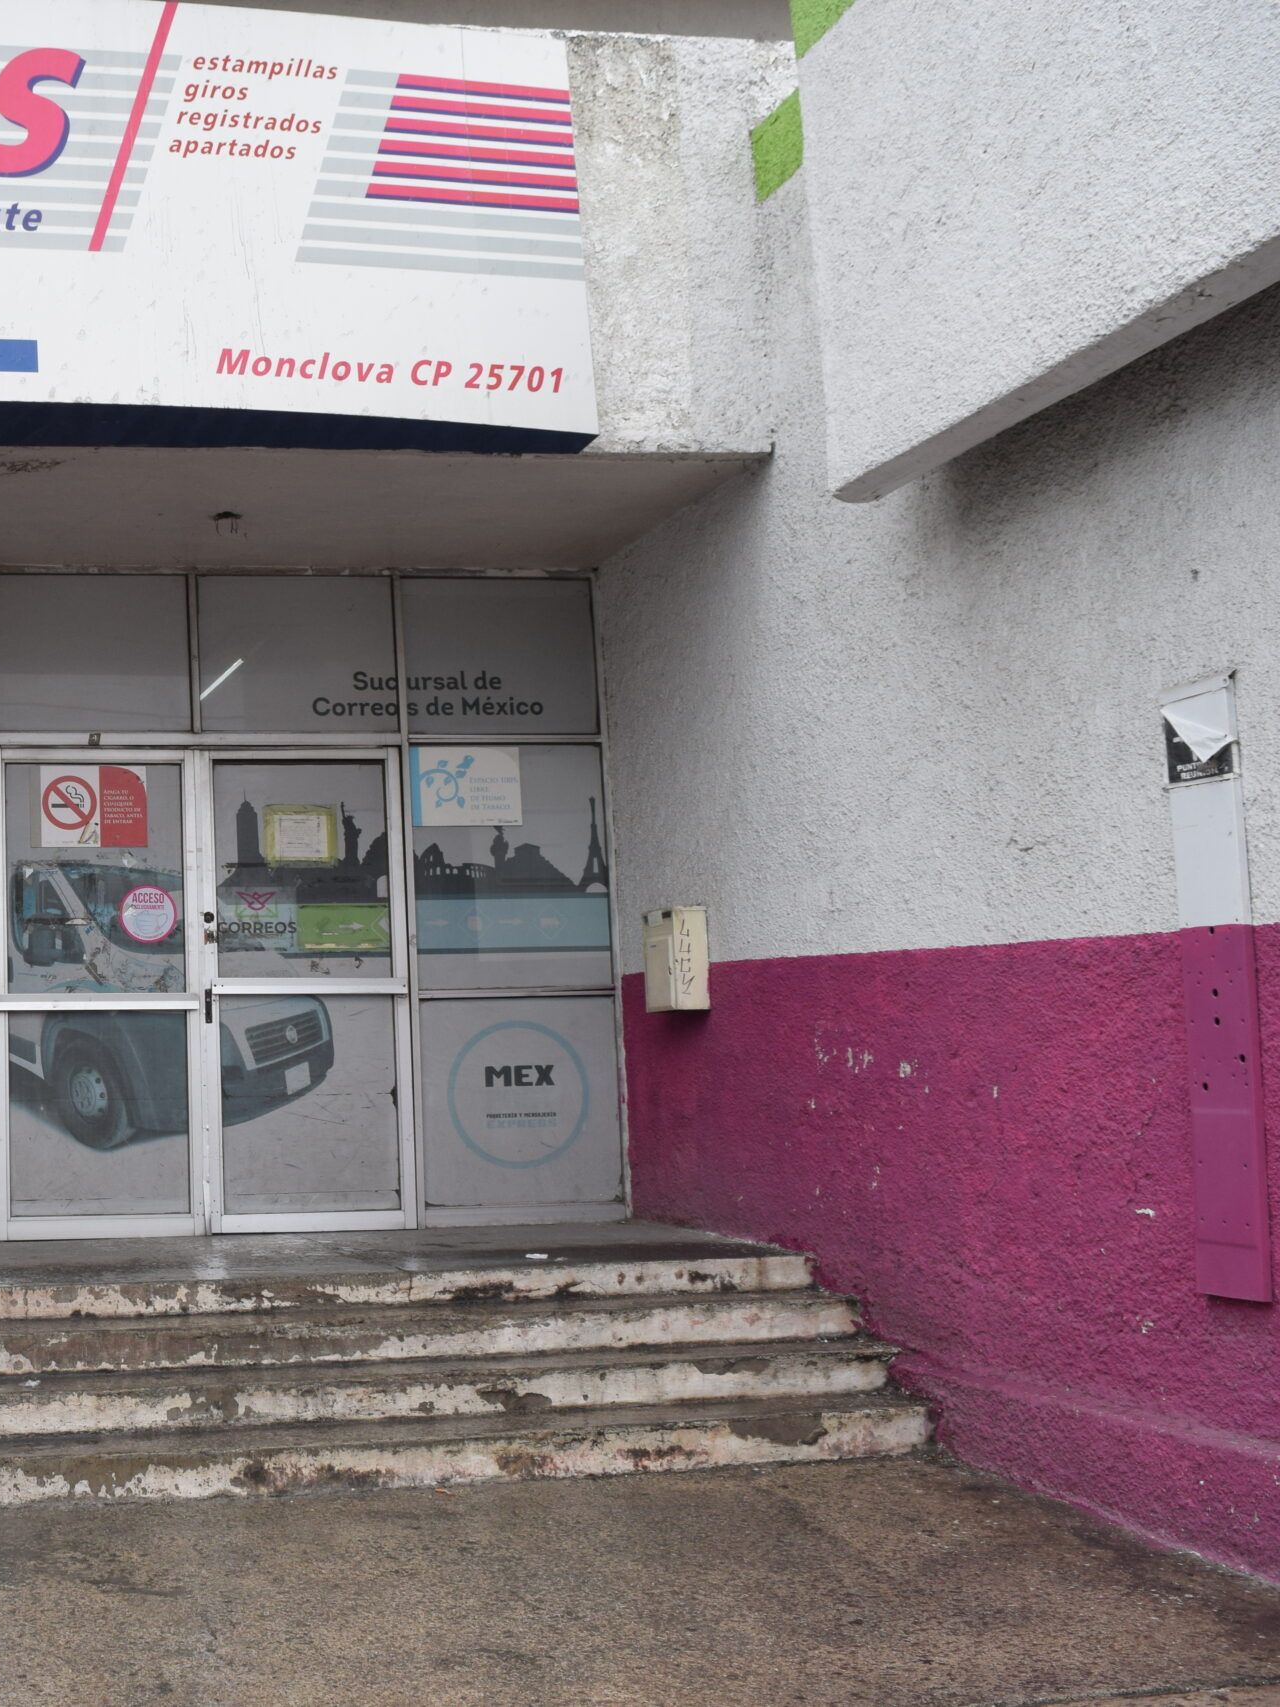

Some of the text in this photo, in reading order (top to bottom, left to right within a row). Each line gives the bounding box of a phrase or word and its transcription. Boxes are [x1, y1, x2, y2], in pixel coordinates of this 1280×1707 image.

[193, 54, 338, 81] estampillas
[184, 80, 248, 102] giros
[177, 108, 322, 135] registrados
[169, 136, 297, 160] apartados
[216, 348, 564, 393] Monclova CP 25701
[353, 671, 502, 691] Sucursal de
[312, 696, 544, 716] Correos de México
[132, 892, 165, 904] ACCESO
[218, 921, 297, 934] CORREOS
[484, 1065, 555, 1087] MEX
